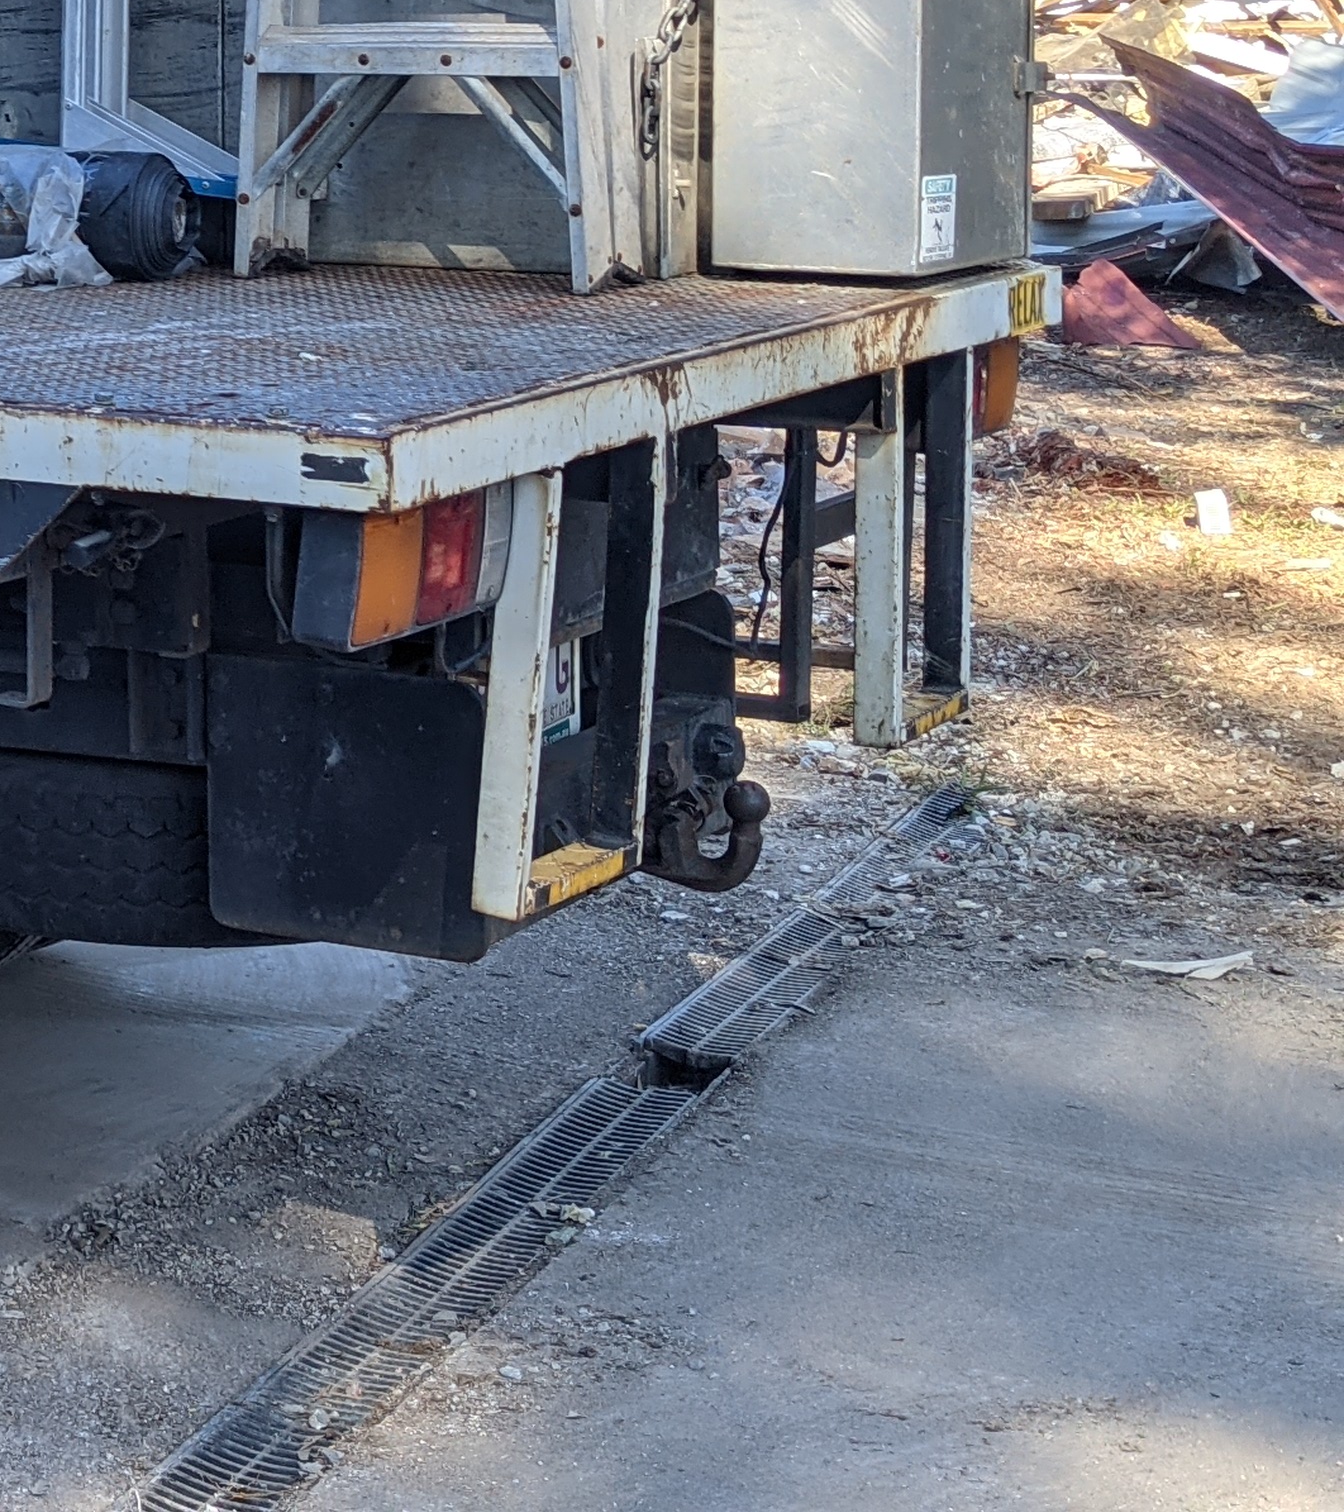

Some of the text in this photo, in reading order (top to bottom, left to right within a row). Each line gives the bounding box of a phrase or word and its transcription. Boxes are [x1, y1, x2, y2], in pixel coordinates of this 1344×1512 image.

[927, 178, 952, 192] SAFETY
[927, 204, 951, 215] HAZARD
[1008, 272, 1046, 329] RELAX
